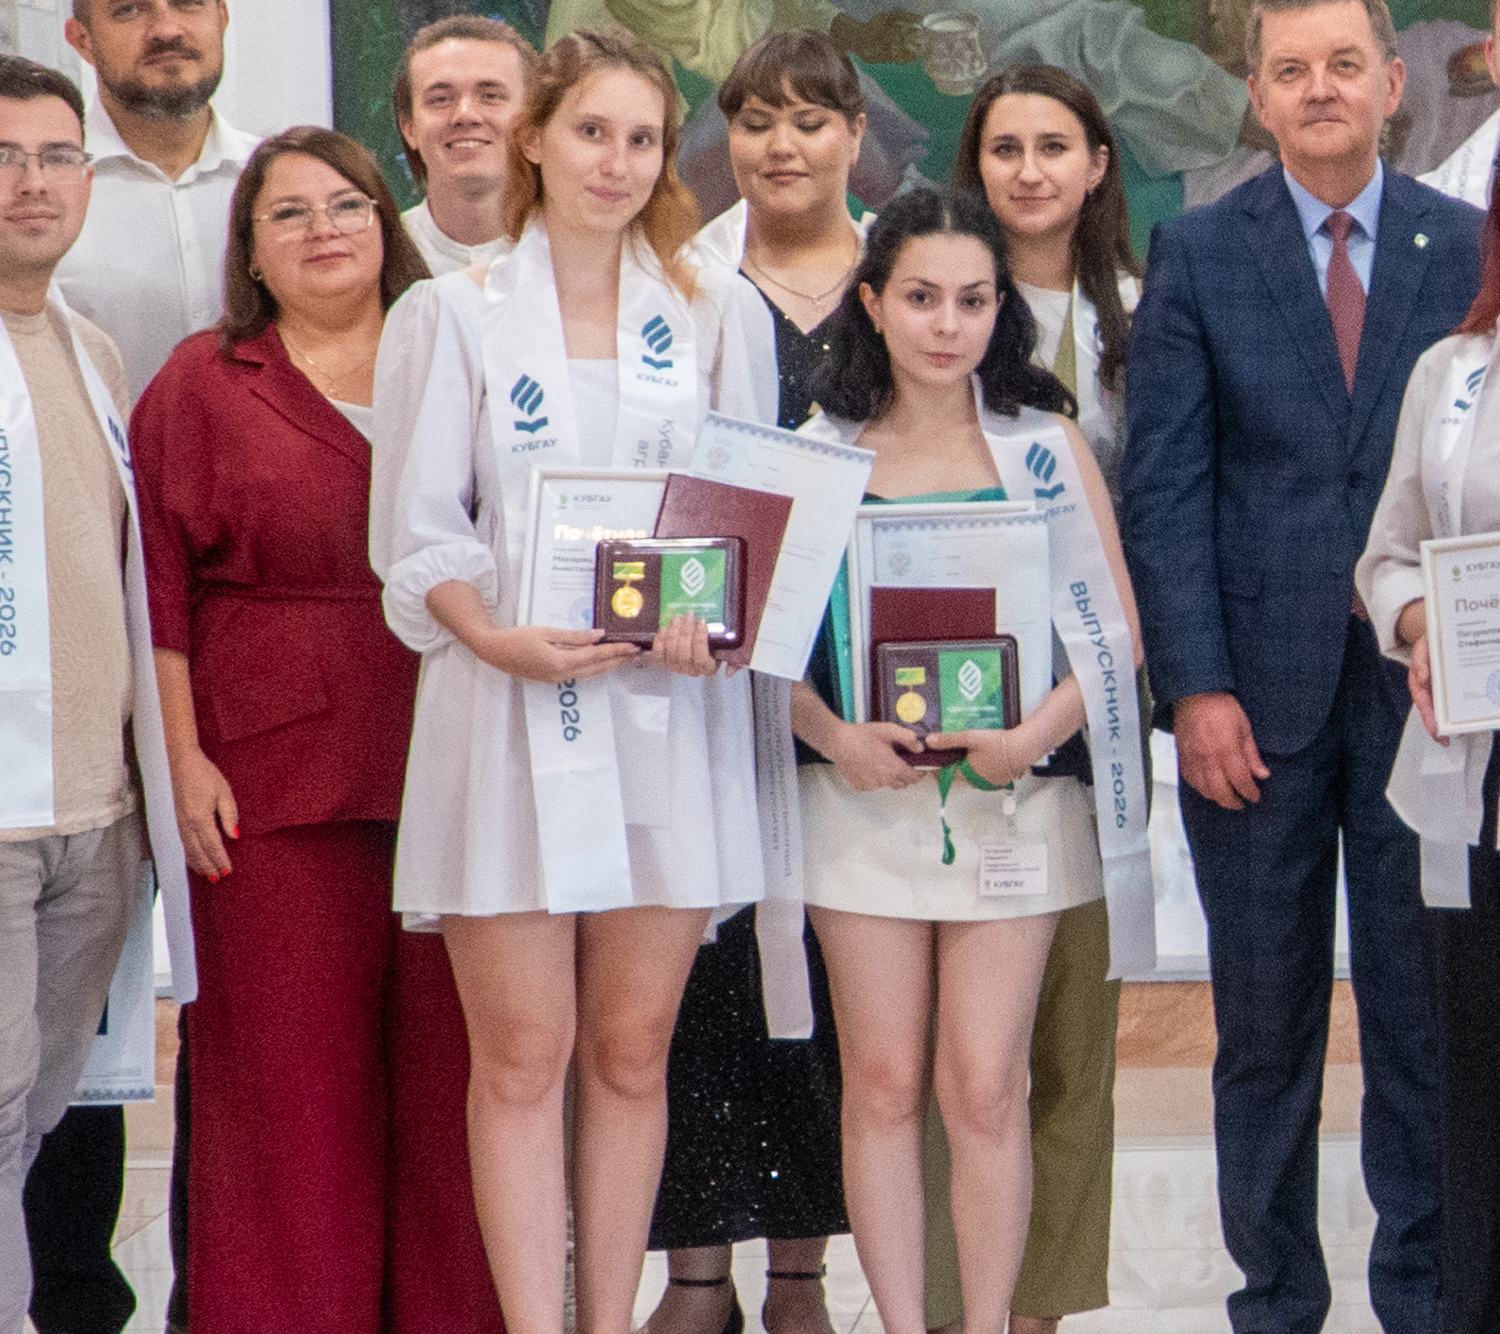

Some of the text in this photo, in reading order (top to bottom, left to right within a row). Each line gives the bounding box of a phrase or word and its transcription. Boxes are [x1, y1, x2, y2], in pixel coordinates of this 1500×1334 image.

[636, 372, 679, 387] КУБГАУ
[511, 438, 557, 454] КУБГАУ
[1070, 580, 1121, 741] ВЫПУСКНИК
[1111, 762, 1127, 829] 2026
